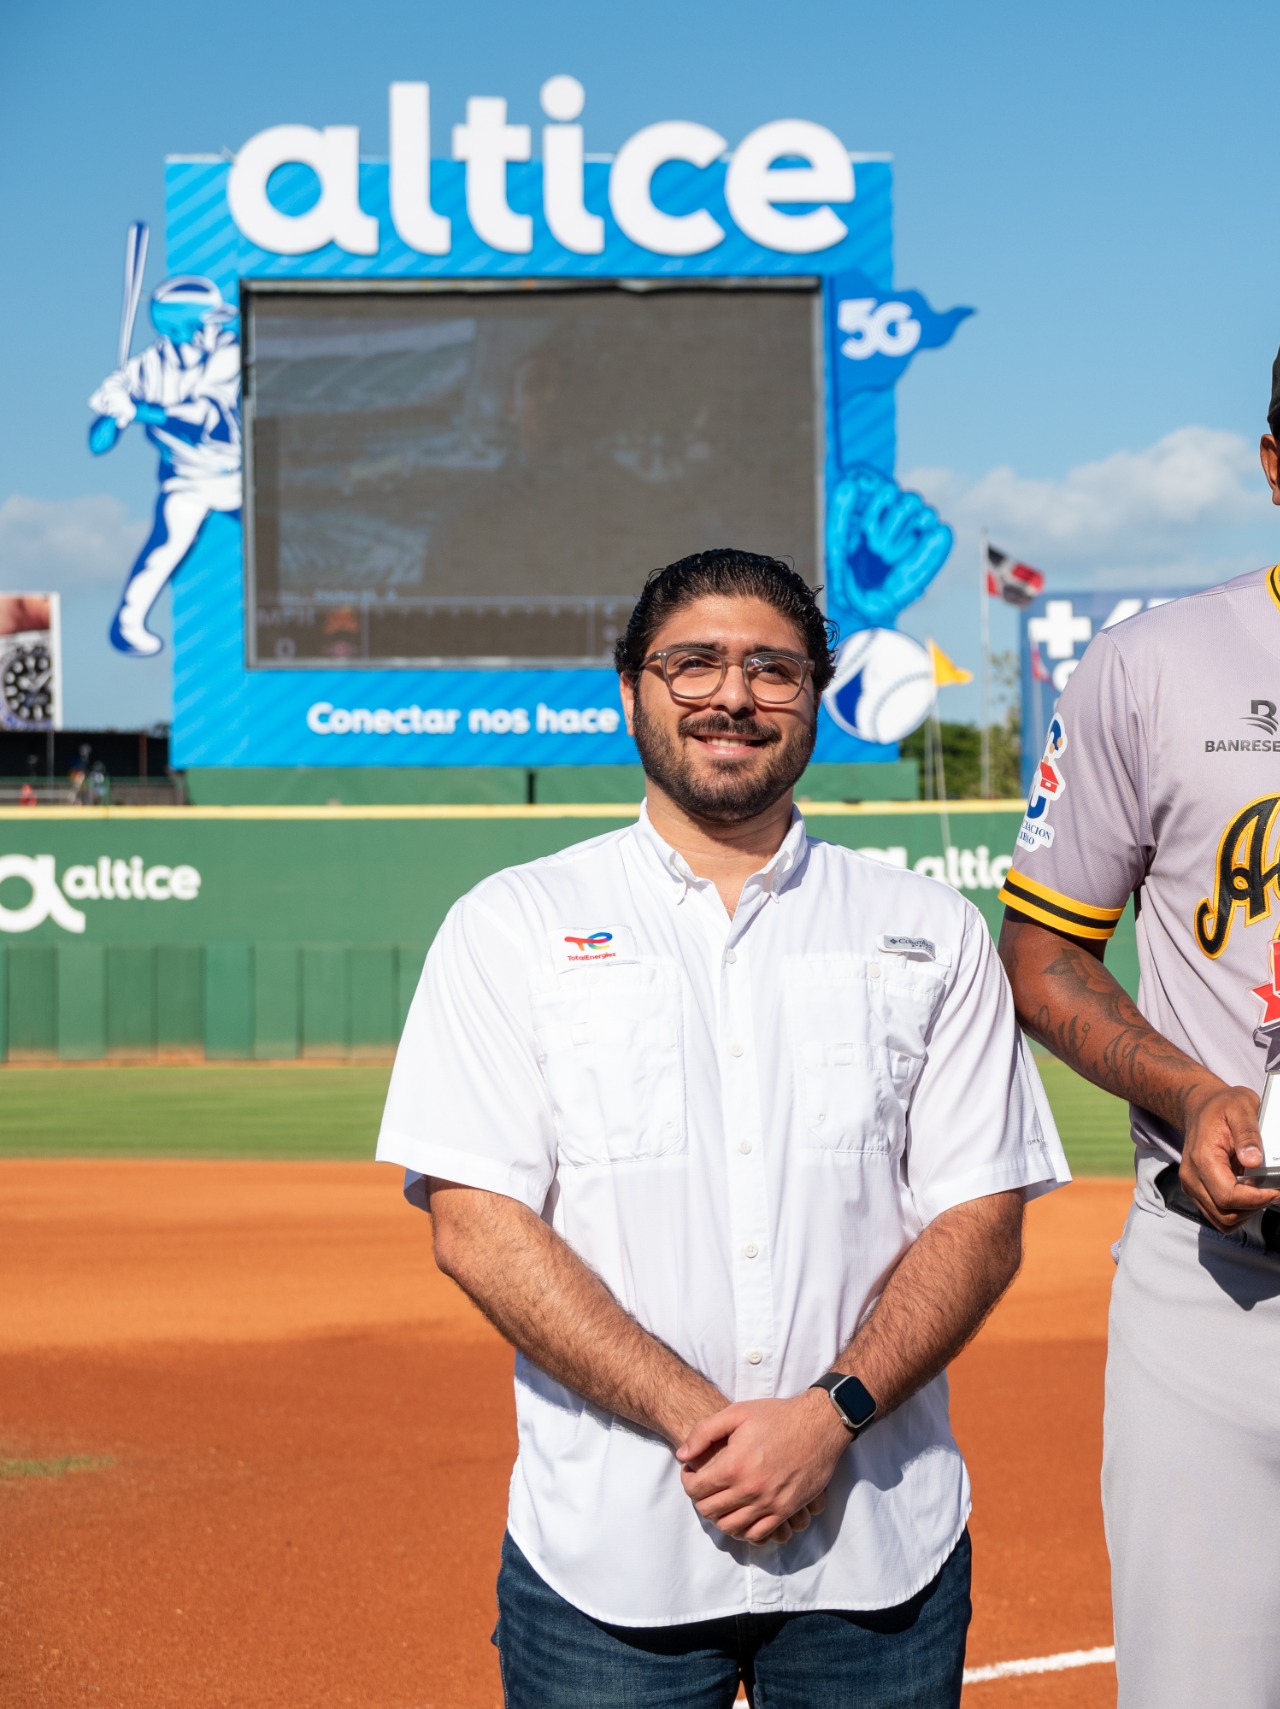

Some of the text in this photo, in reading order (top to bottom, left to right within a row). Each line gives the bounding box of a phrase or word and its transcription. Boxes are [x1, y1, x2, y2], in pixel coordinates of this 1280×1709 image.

[225, 74, 856, 257] altice
[838, 297, 922, 361] 5G
[306, 702, 621, 735] Conectar nos hace
[62, 855, 201, 900] altice
[567, 952, 617, 963] TotalEnergies
